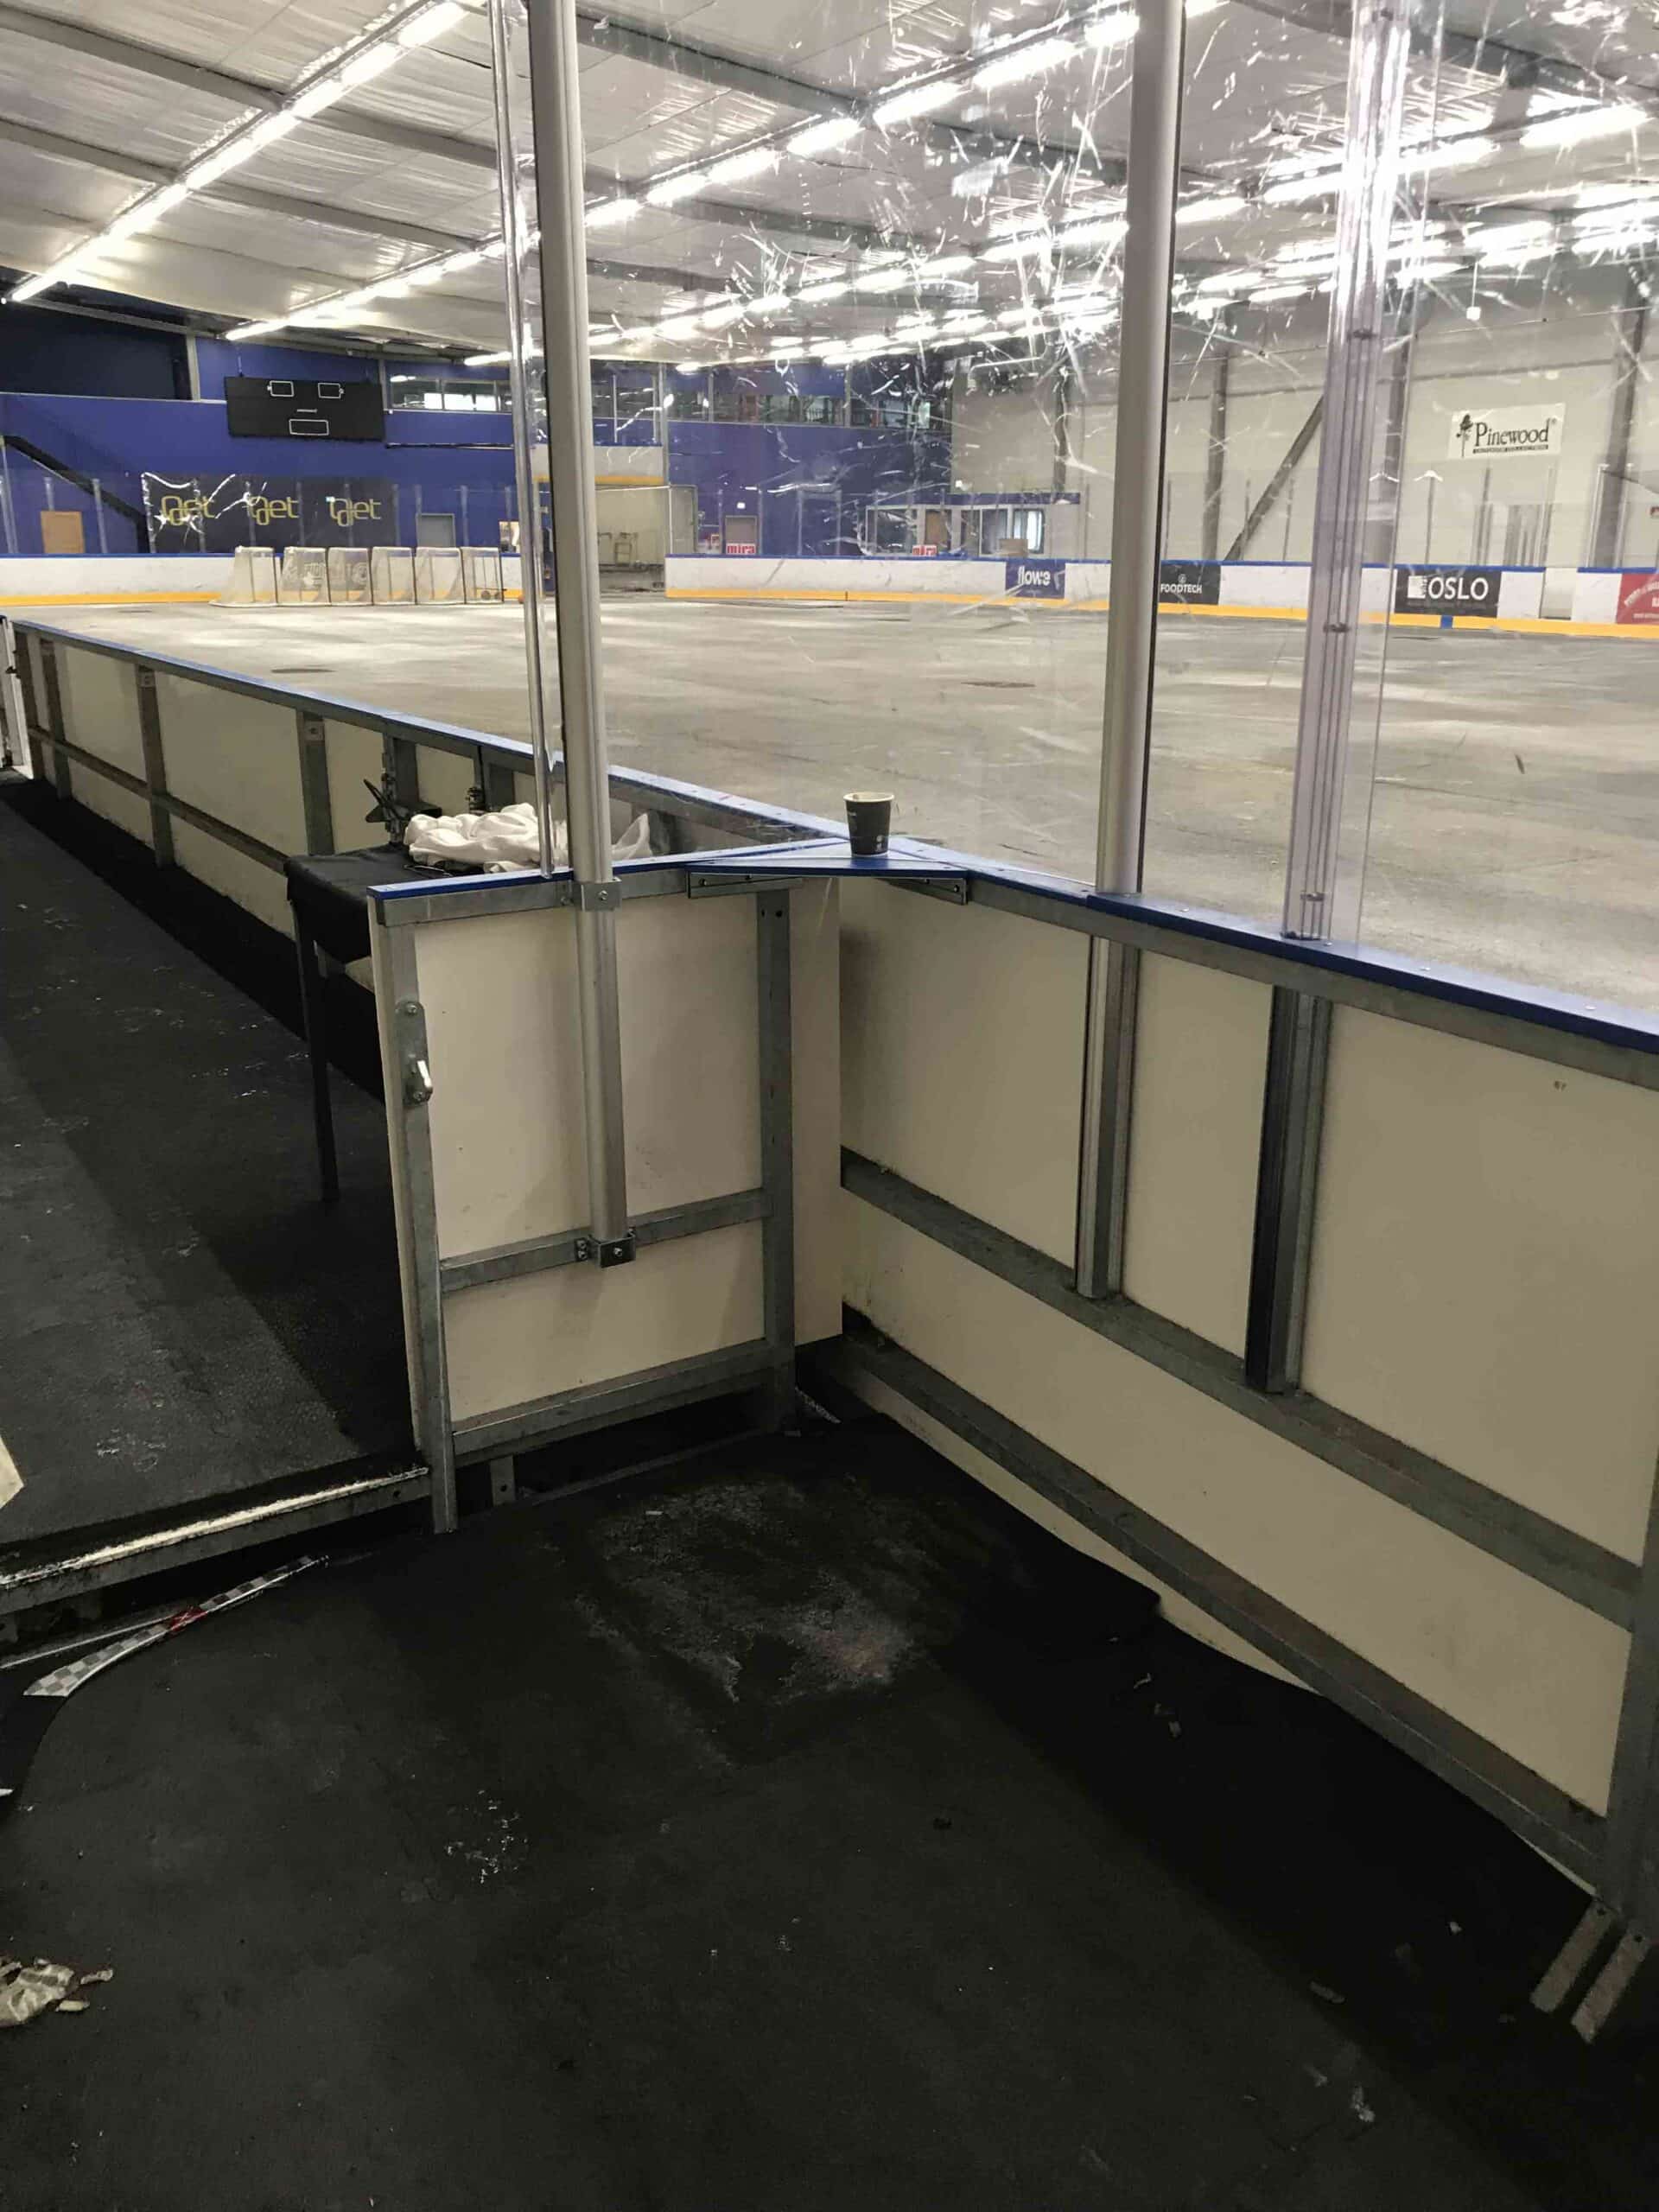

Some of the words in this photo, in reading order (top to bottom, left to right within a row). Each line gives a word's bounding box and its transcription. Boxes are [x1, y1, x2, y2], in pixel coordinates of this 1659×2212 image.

[1474, 418, 1550, 447] Pinewood
[727, 544, 755, 554] mira
[1160, 583, 1202, 594] FOODTECH
[1428, 576, 1489, 601] OSLO
